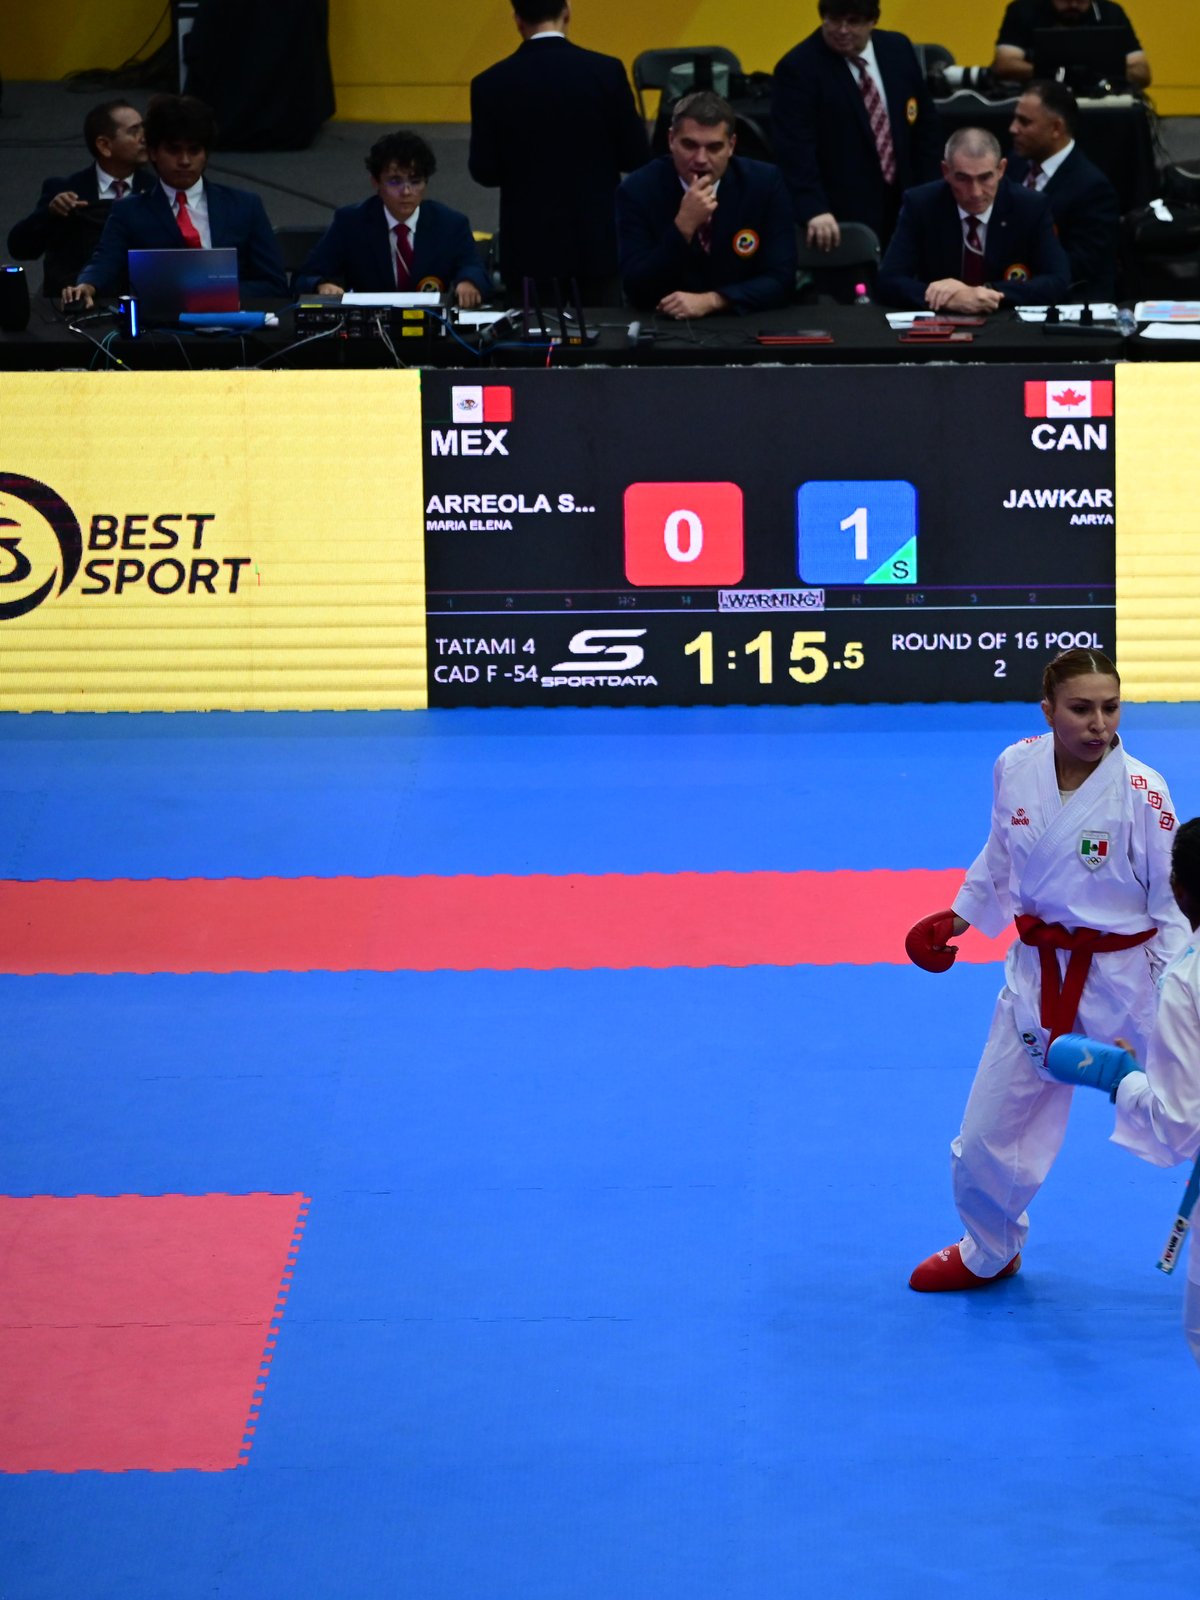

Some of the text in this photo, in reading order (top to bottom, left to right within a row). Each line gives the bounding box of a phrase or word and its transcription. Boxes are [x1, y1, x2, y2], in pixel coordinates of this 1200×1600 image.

[431, 429, 508, 455] MEX
[1032, 424, 1106, 450] CAN
[426, 494, 552, 513] ARREOLA
[1003, 489, 1113, 508] JAWKAR
[427, 520, 512, 530] MARIA ELENA
[1070, 514, 1113, 525] AARYA
[88, 514, 215, 550] BEST
[664, 510, 702, 561] 0
[841, 508, 867, 560] 1
[81, 557, 251, 595] SPORT
[893, 560, 908, 579] S
[436, 638, 535, 654] TATAMI 4
[893, 632, 1104, 650] ROUND OF 16 POOL
[434, 665, 538, 682] CAD F -54
[994, 660, 1006, 677] 2
[541, 676, 657, 687] SPORTDATA
[1011, 816, 1030, 826] Daedo
